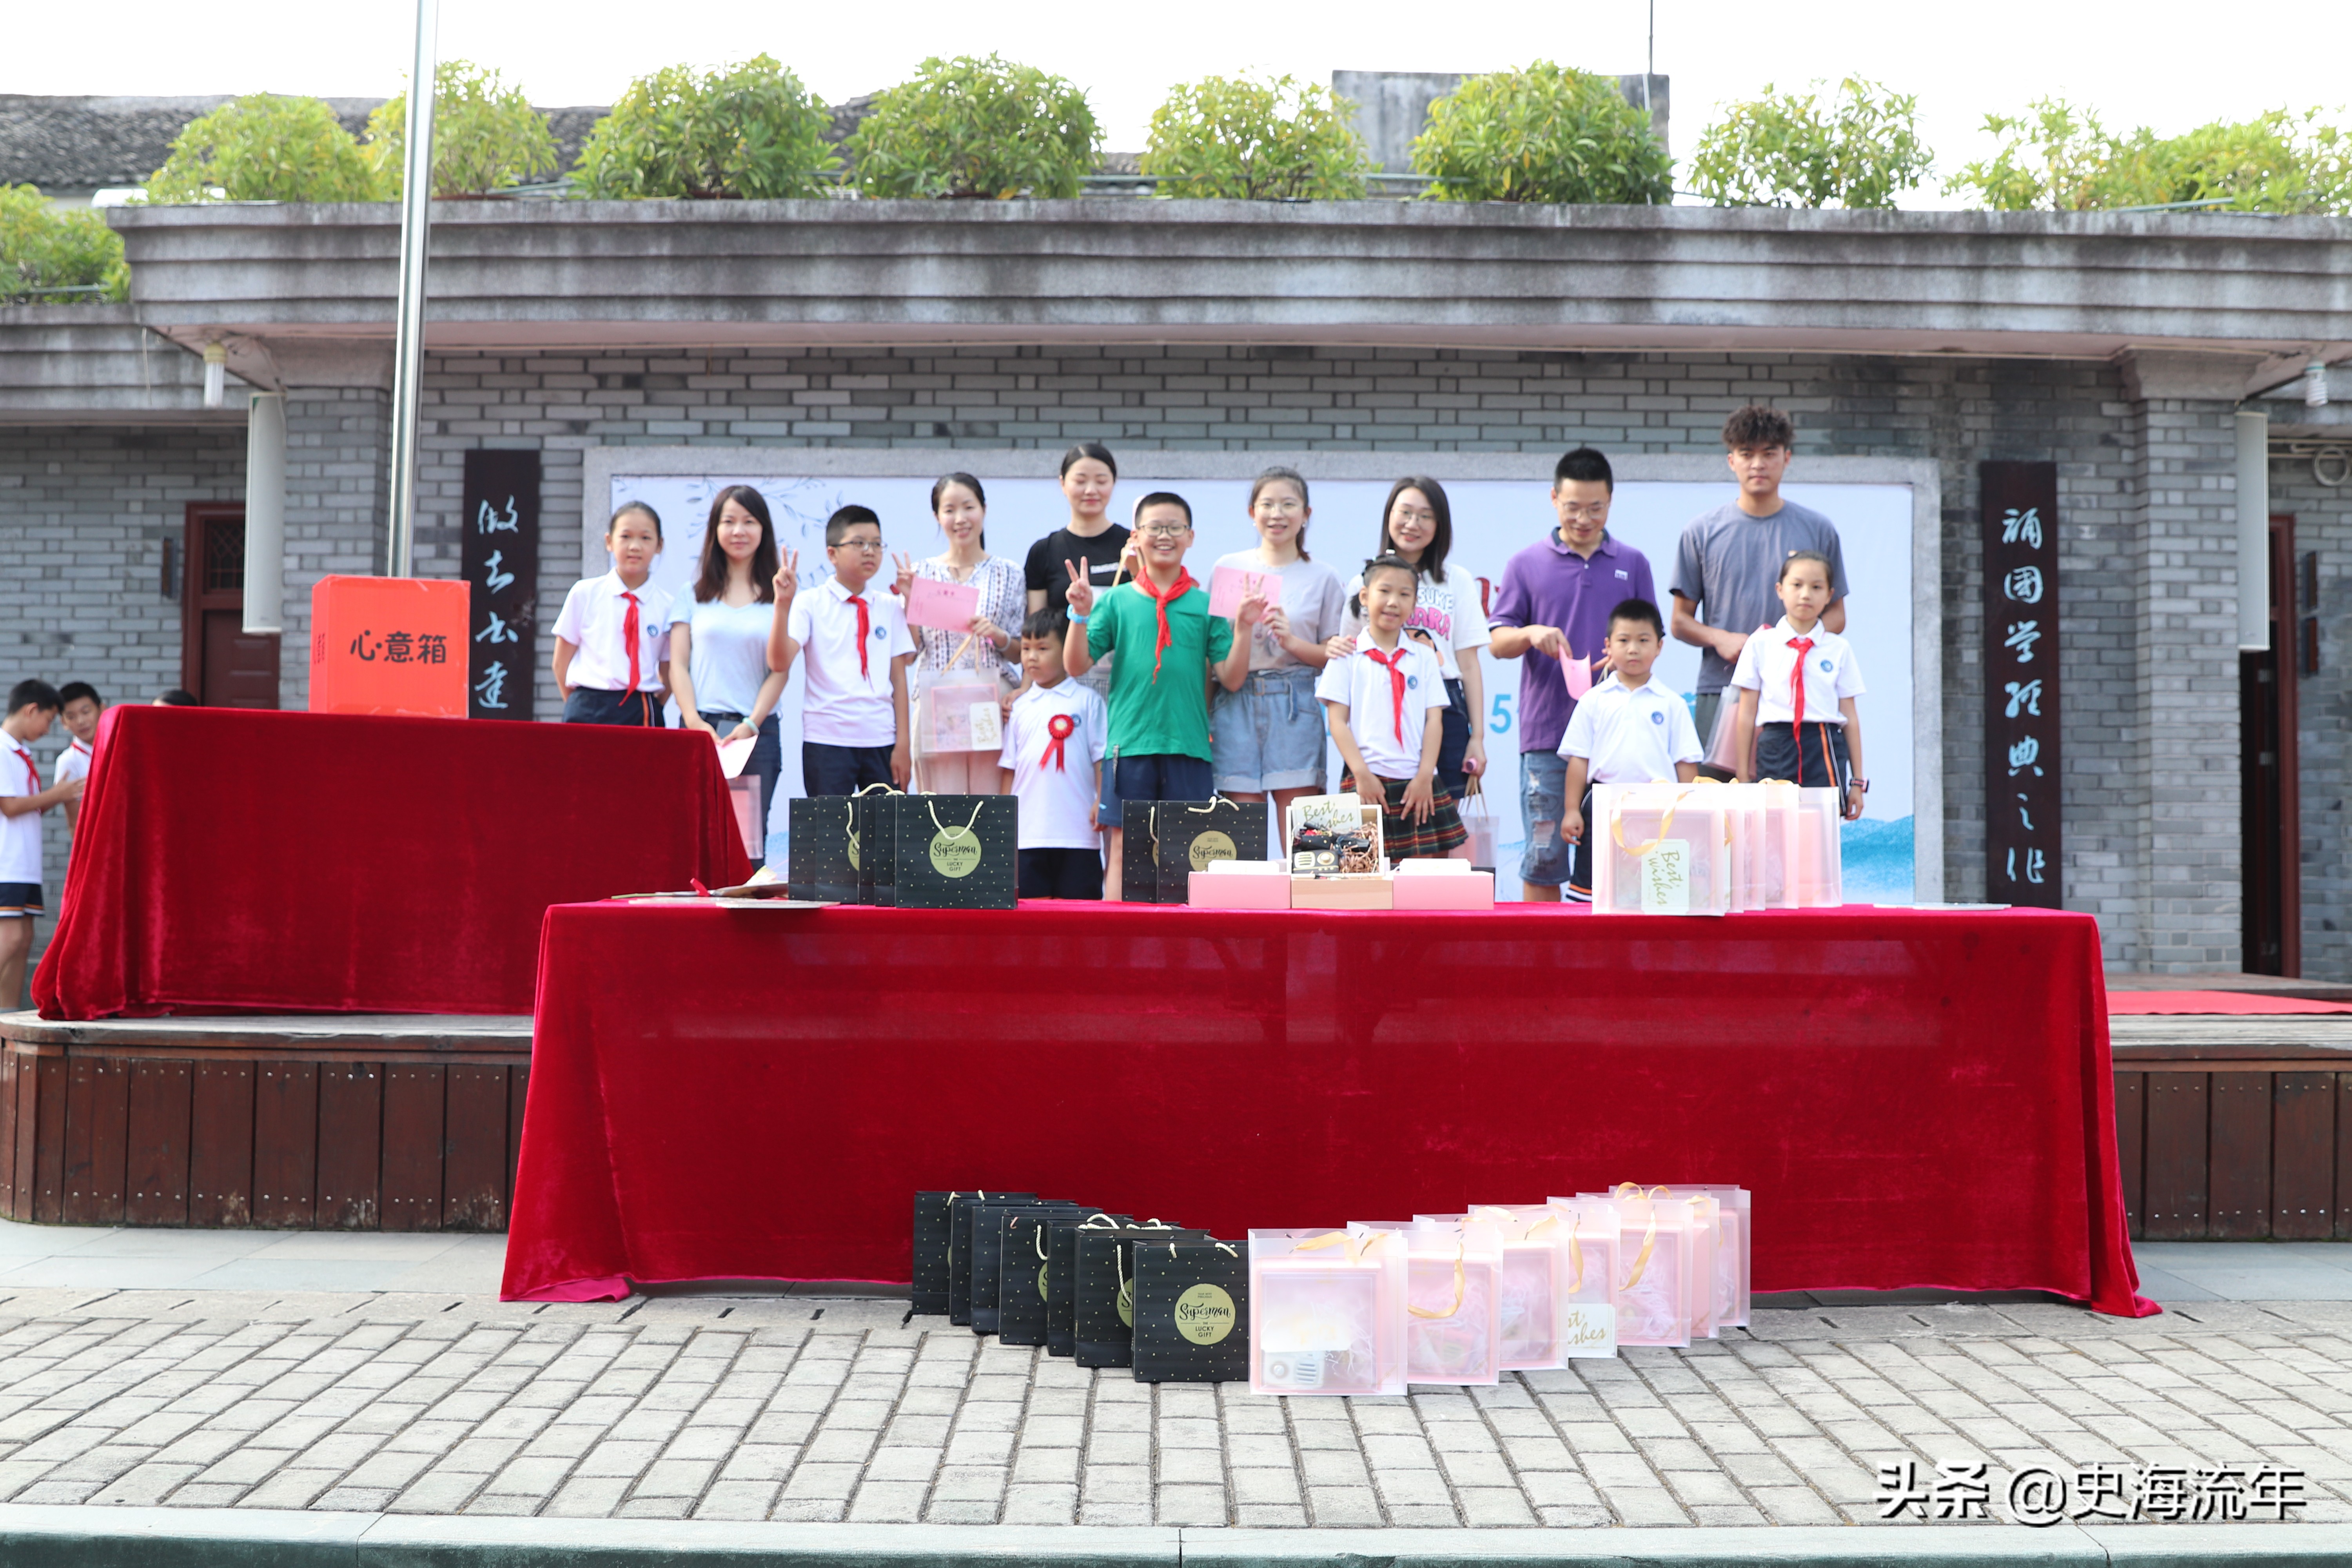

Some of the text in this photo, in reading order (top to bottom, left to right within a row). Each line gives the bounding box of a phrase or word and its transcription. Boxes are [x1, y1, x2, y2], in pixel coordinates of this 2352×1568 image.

[350, 630, 446, 664] 心意箱
[1317, 809, 1354, 829] ishes
[933, 842, 978, 857] Superman
[1192, 846, 1233, 859] Superman
[1179, 1303, 1231, 1321] Superman
[1568, 1310, 1583, 1328] st
